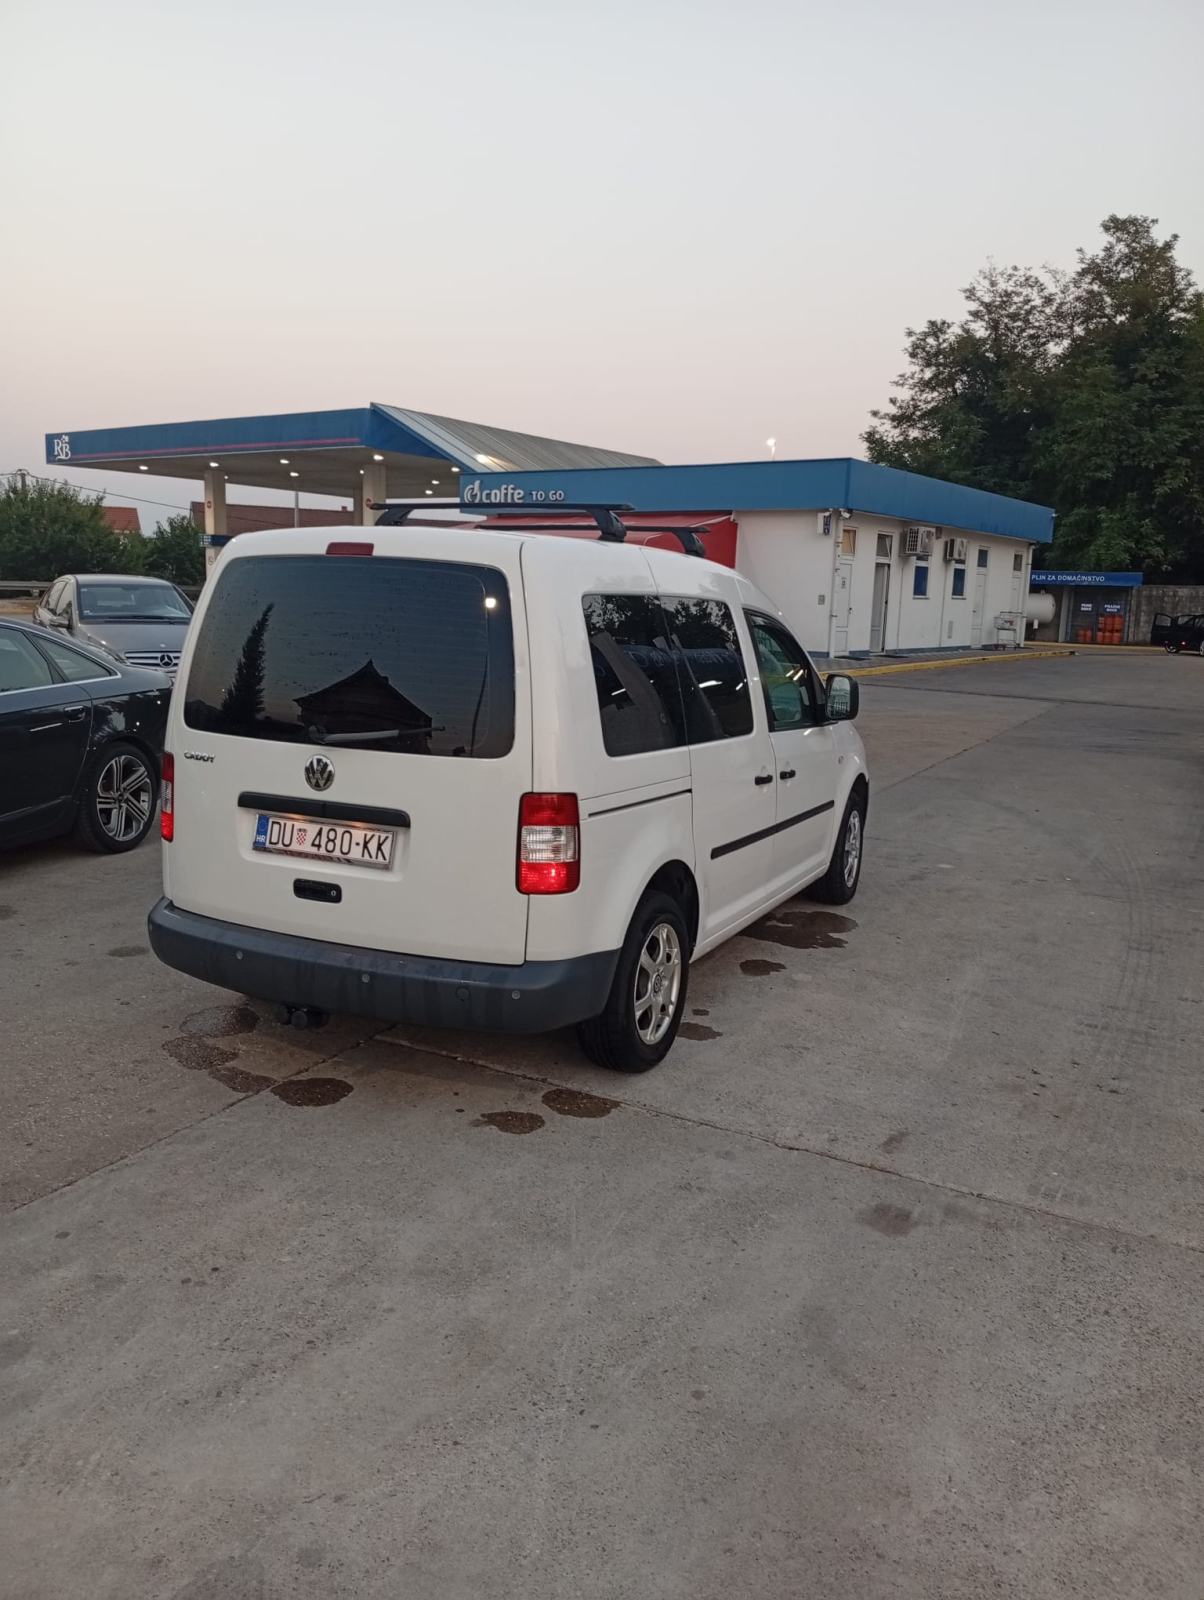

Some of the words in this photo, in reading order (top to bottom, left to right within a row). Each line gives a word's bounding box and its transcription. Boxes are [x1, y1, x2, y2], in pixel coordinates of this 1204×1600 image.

[481, 484, 524, 503] coffe
[531, 490, 545, 501] TO
[549, 490, 565, 501] GO
[256, 834, 266, 843] HR
[269, 820, 295, 848] DU
